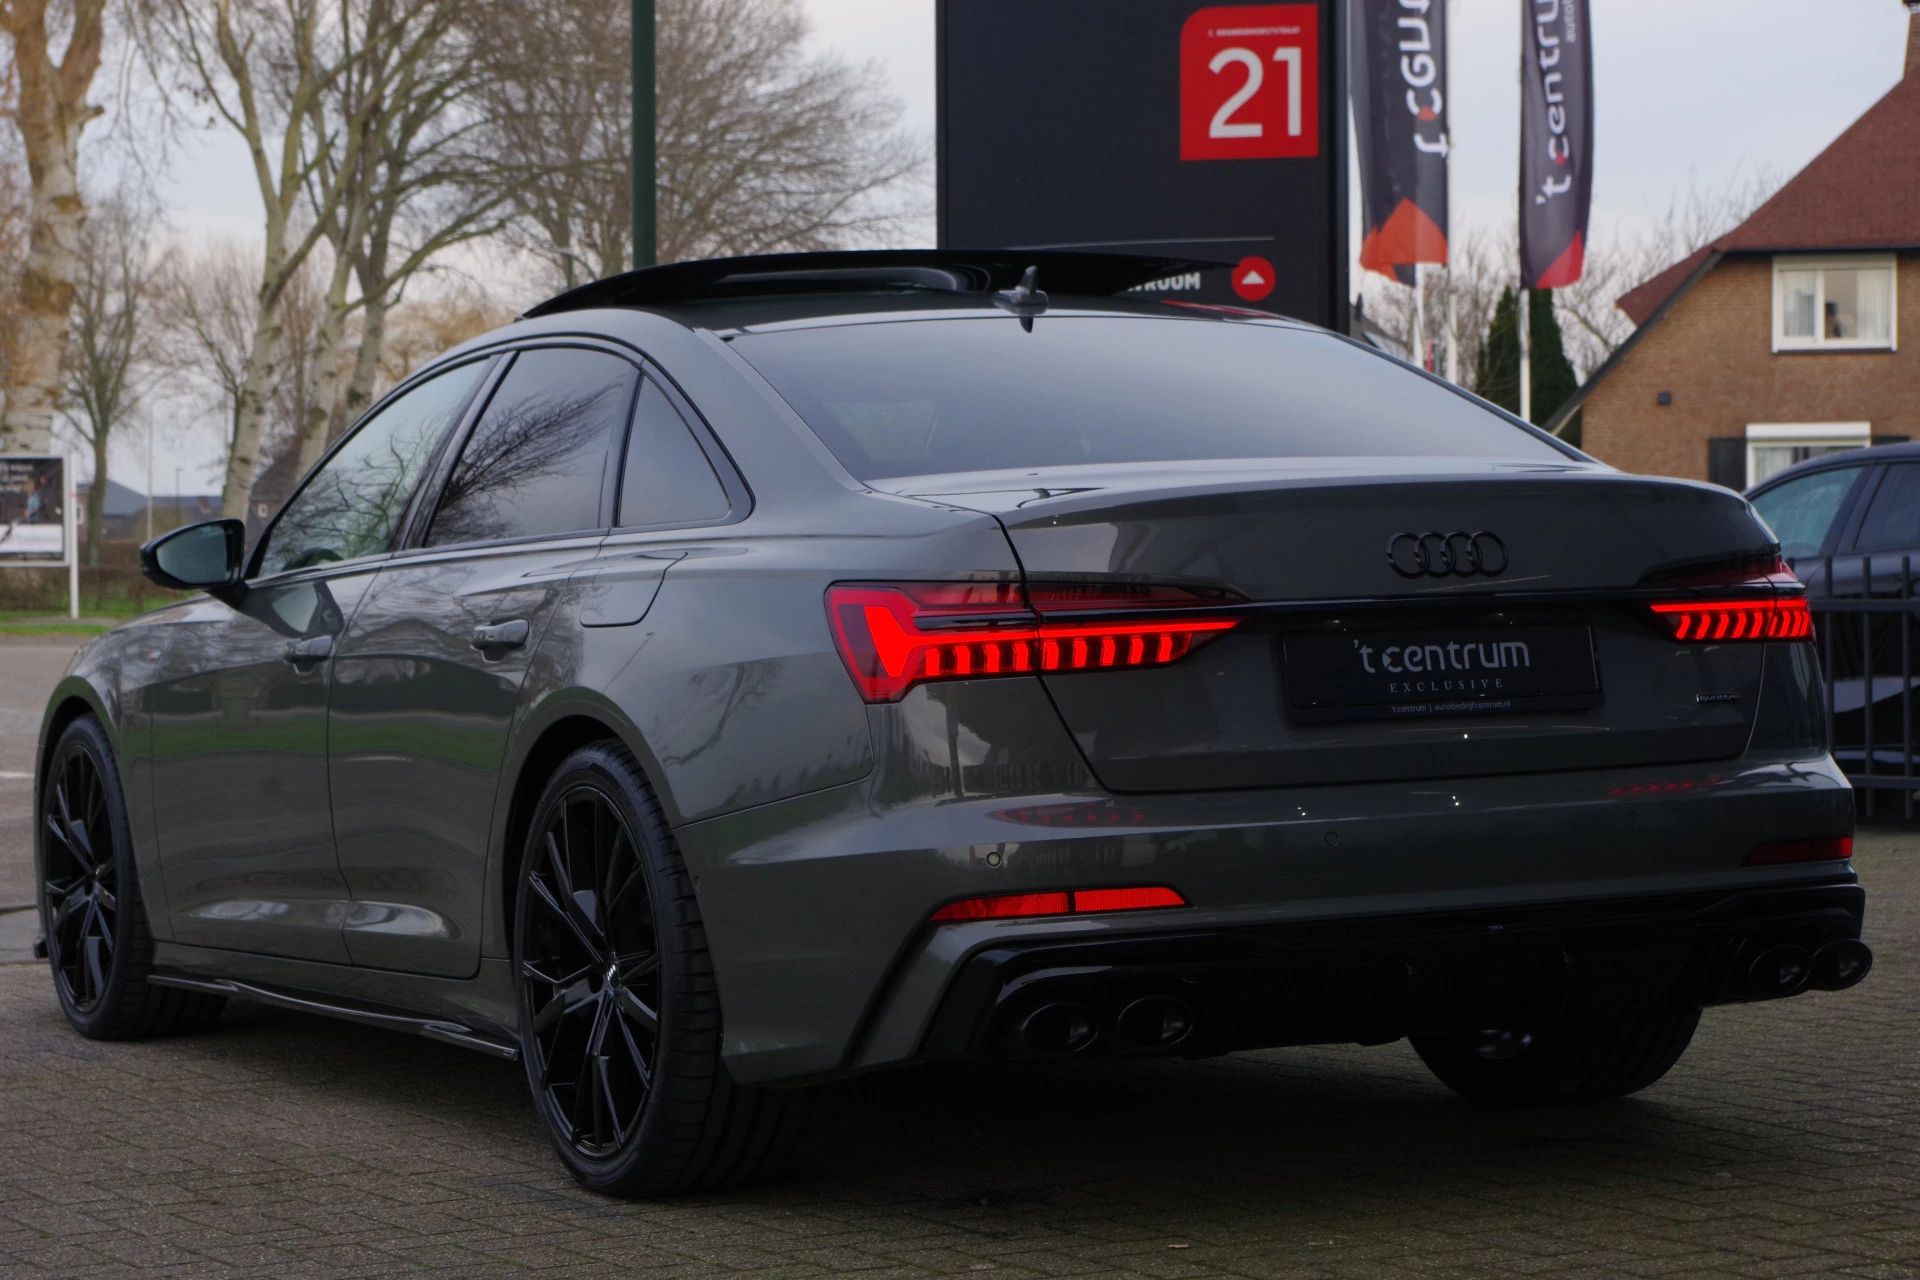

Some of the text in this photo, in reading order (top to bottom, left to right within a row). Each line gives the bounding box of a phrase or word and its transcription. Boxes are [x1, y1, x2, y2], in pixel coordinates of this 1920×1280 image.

[1208, 46, 1302, 139] 21
[1352, 639, 1531, 674] 't centrum
[1389, 678, 1503, 694] EXCLUSIVE
